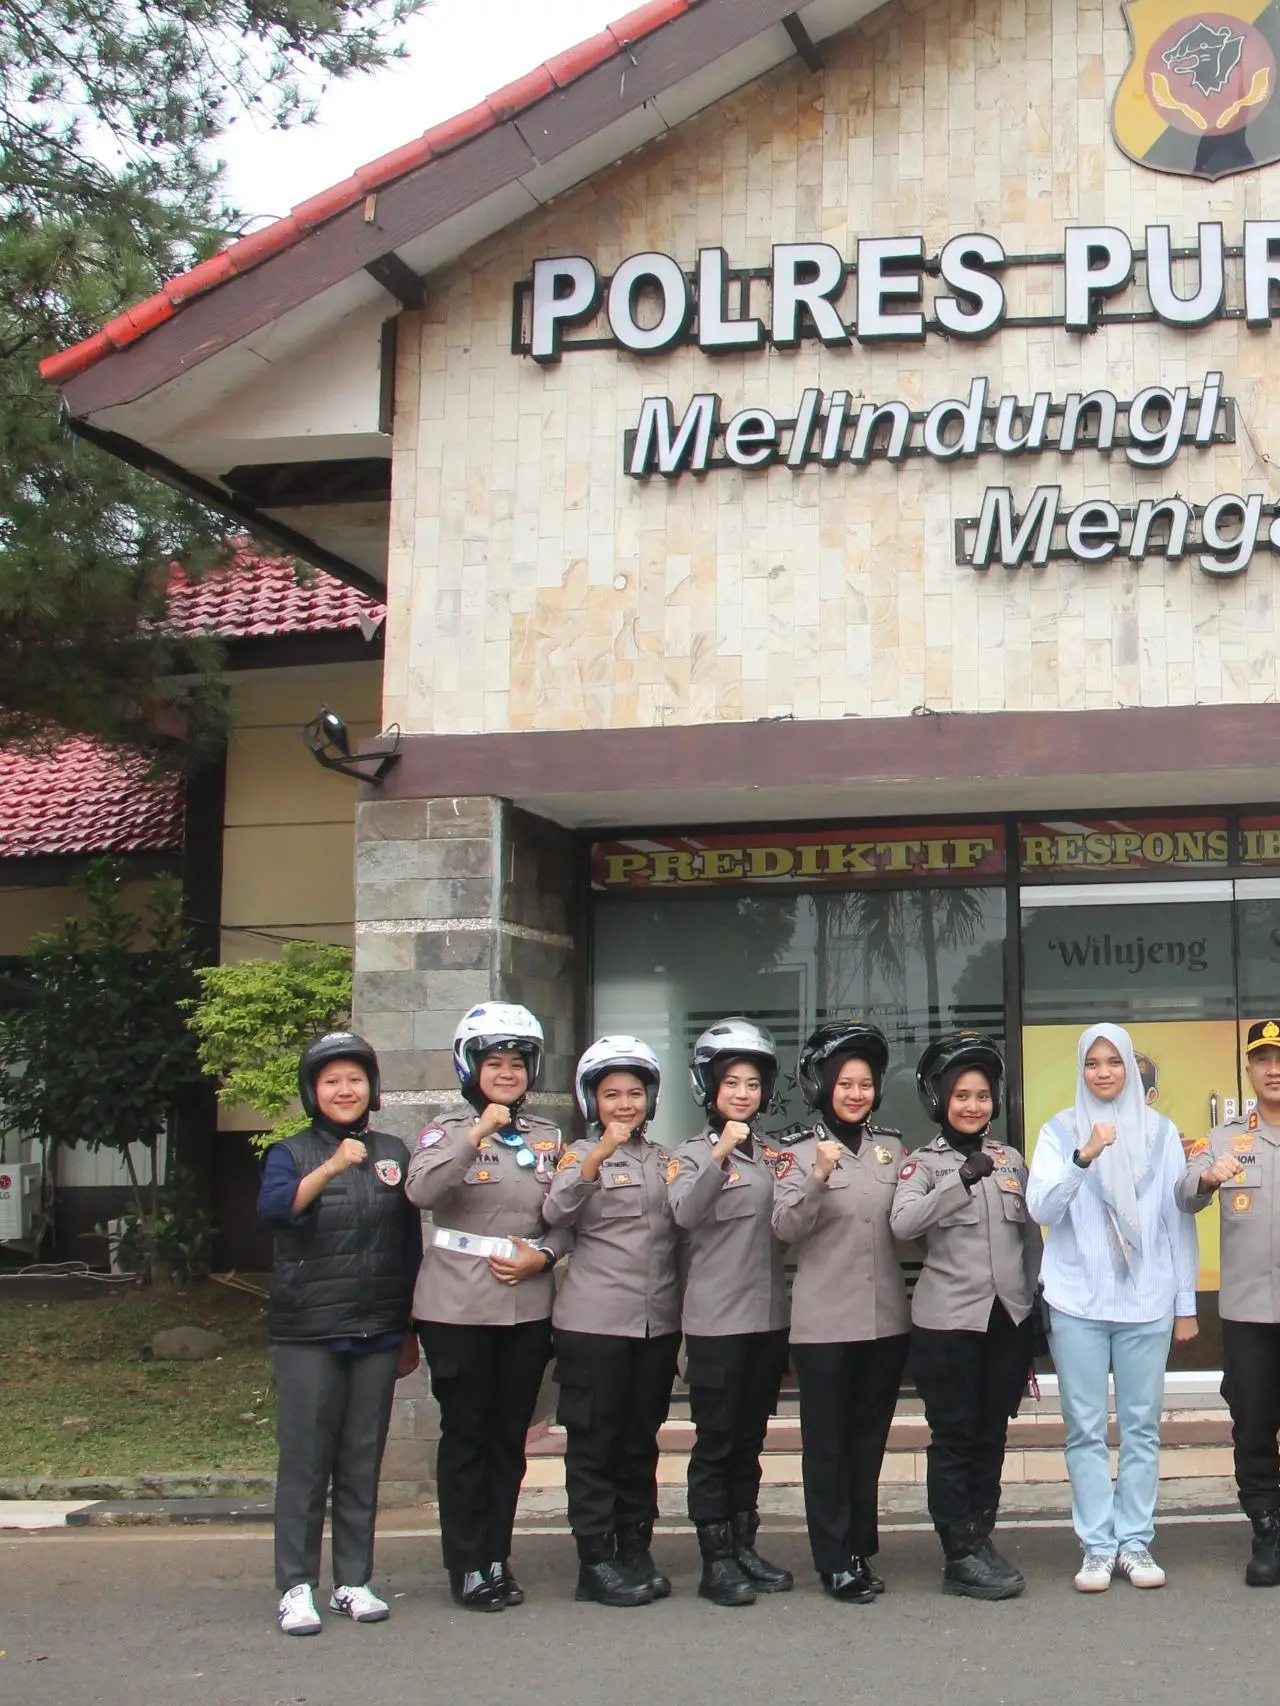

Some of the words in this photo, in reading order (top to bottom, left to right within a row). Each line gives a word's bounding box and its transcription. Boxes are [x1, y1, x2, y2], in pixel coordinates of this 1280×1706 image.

[532, 232, 1007, 363] POLRES
[626, 371, 1224, 479] Melindungi
[604, 838, 994, 885] PREDIKTIF
